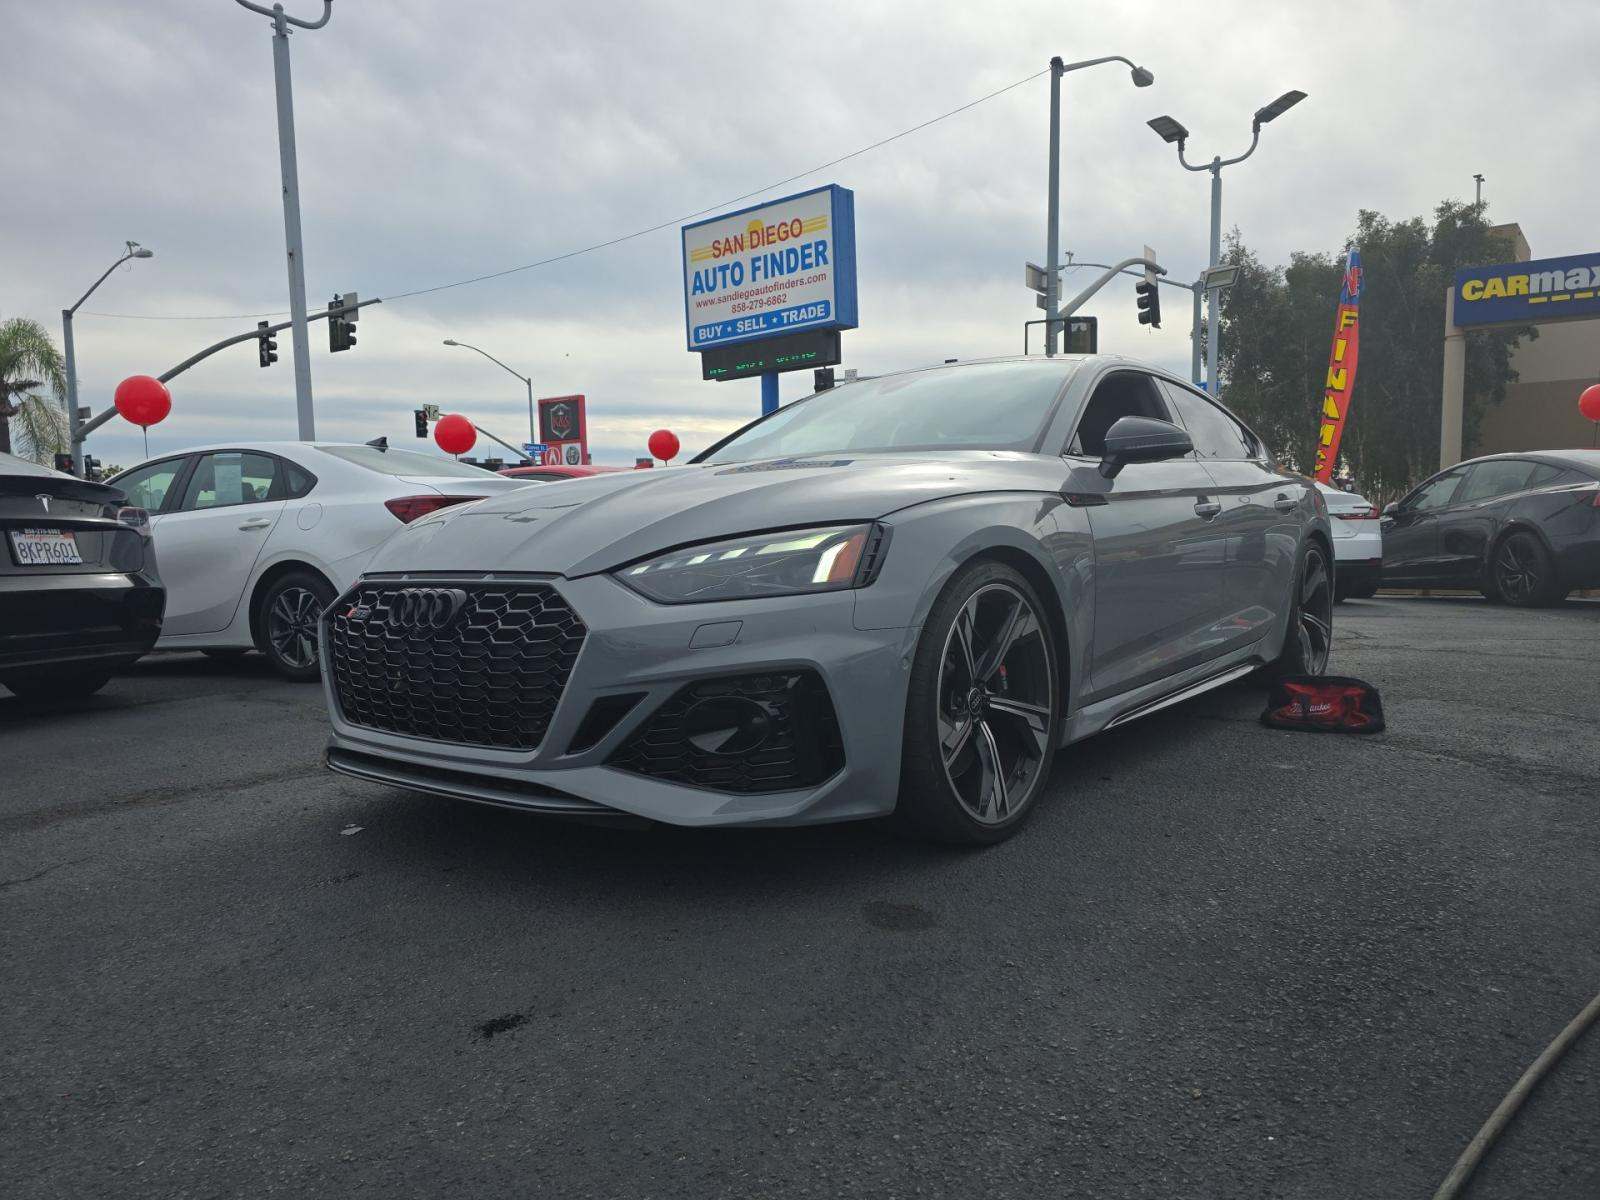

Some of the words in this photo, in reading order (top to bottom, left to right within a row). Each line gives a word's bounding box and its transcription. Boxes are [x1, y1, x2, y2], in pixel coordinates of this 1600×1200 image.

[712, 234, 744, 259] SAN
[750, 218, 803, 249] DIEGO
[692, 261, 745, 296] AUTO
[751, 239, 829, 282] FINDER
[696, 272, 827, 309] www.sandiegoautofinders.com
[731, 293, 788, 313] 858-279-6862
[698, 325, 723, 340] BUY
[736, 316, 767, 333] SELL
[781, 304, 826, 324] TRADE
[18, 542, 80, 559] 8KPR601
